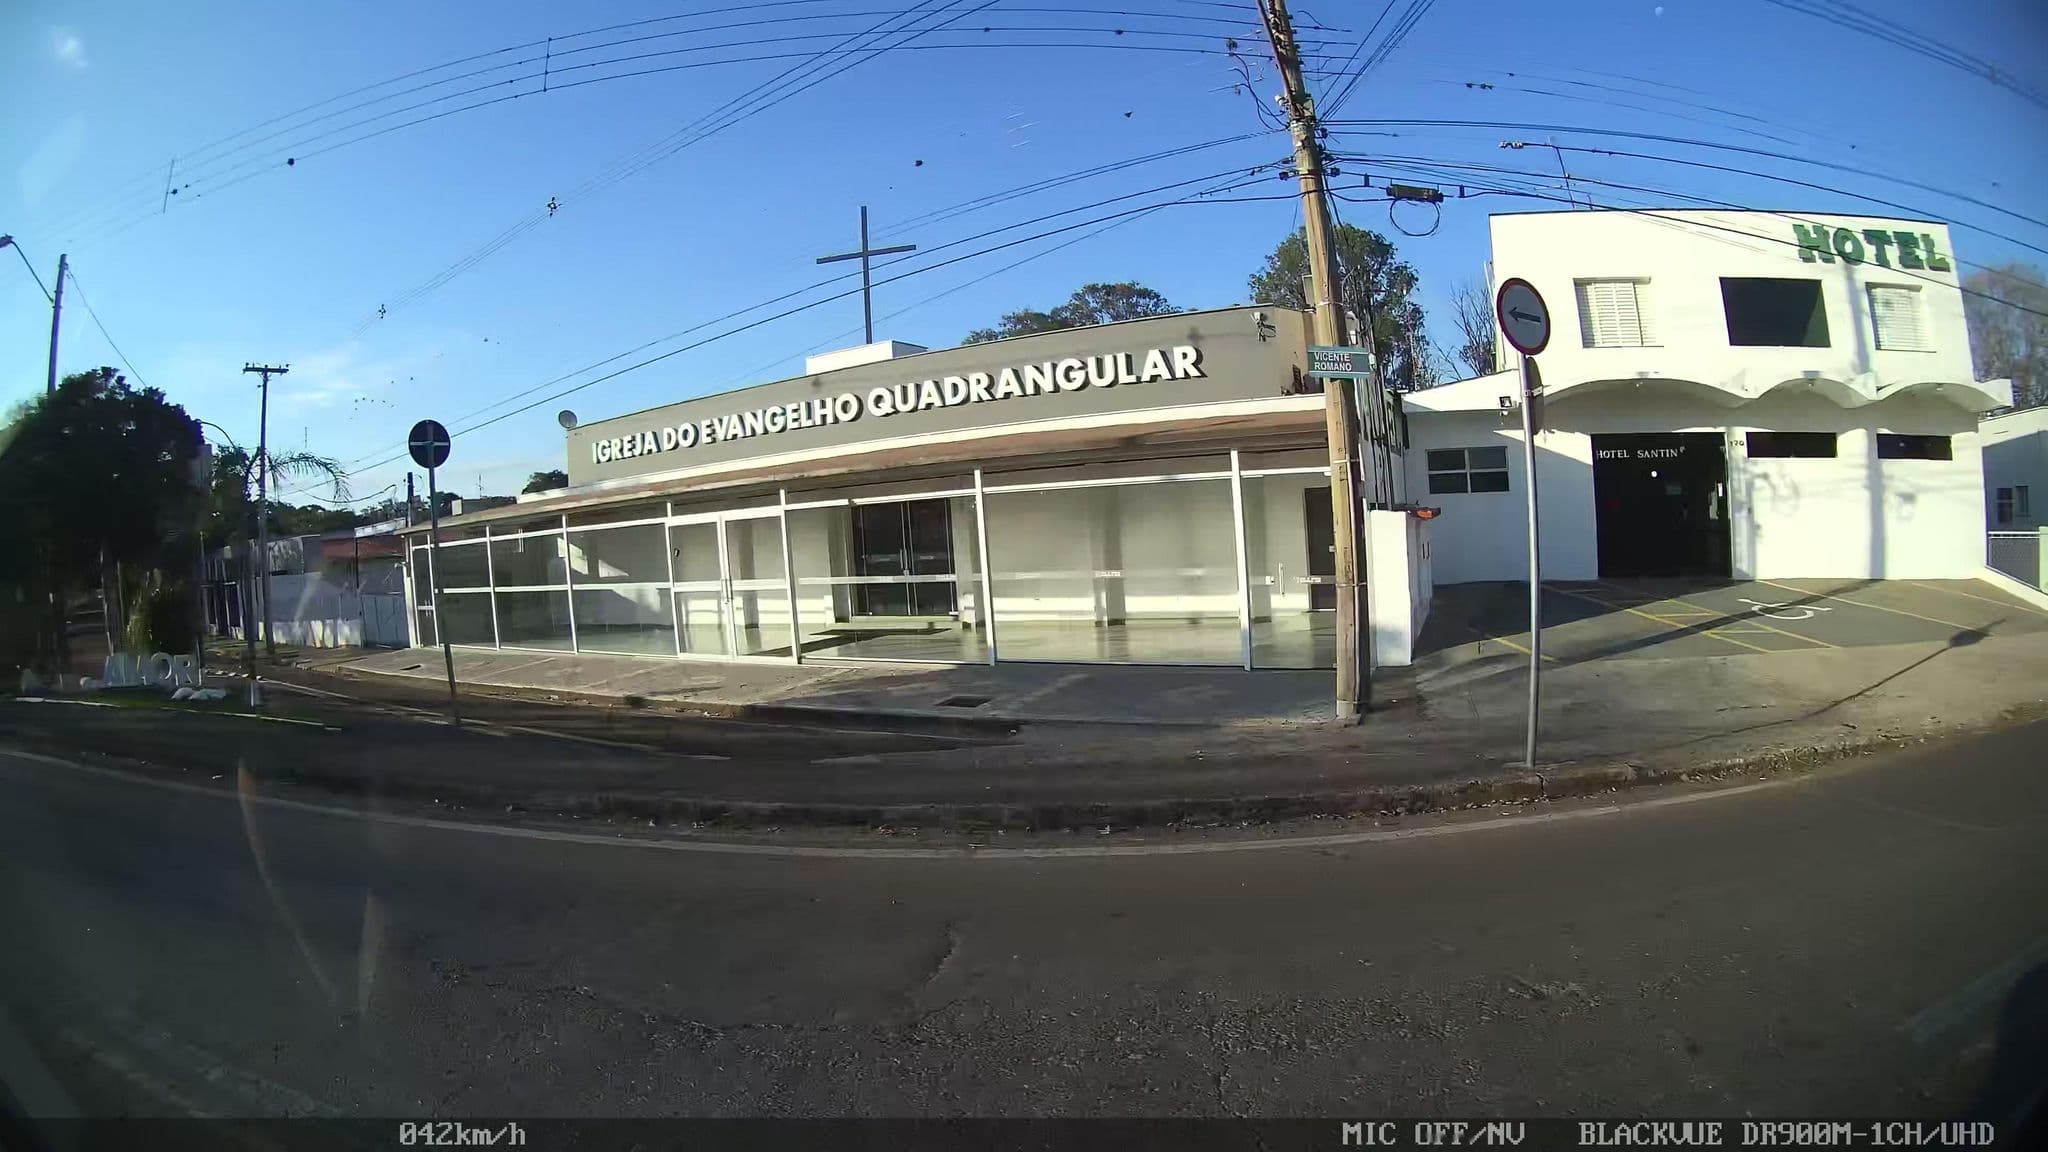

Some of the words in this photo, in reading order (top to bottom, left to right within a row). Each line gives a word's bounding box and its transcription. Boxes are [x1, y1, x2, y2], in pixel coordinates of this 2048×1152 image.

[1792, 224, 1950, 272] HOTEL
[1314, 352, 1351, 361] VICENTE
[1314, 362, 1352, 371] ROMANO
[592, 431, 660, 464] IGREJA
[662, 422, 699, 451] DO
[701, 393, 863, 444] EVANGELHO
[867, 345, 1207, 418] QUADRANGULAR
[1596, 449, 1629, 459] HOTEL
